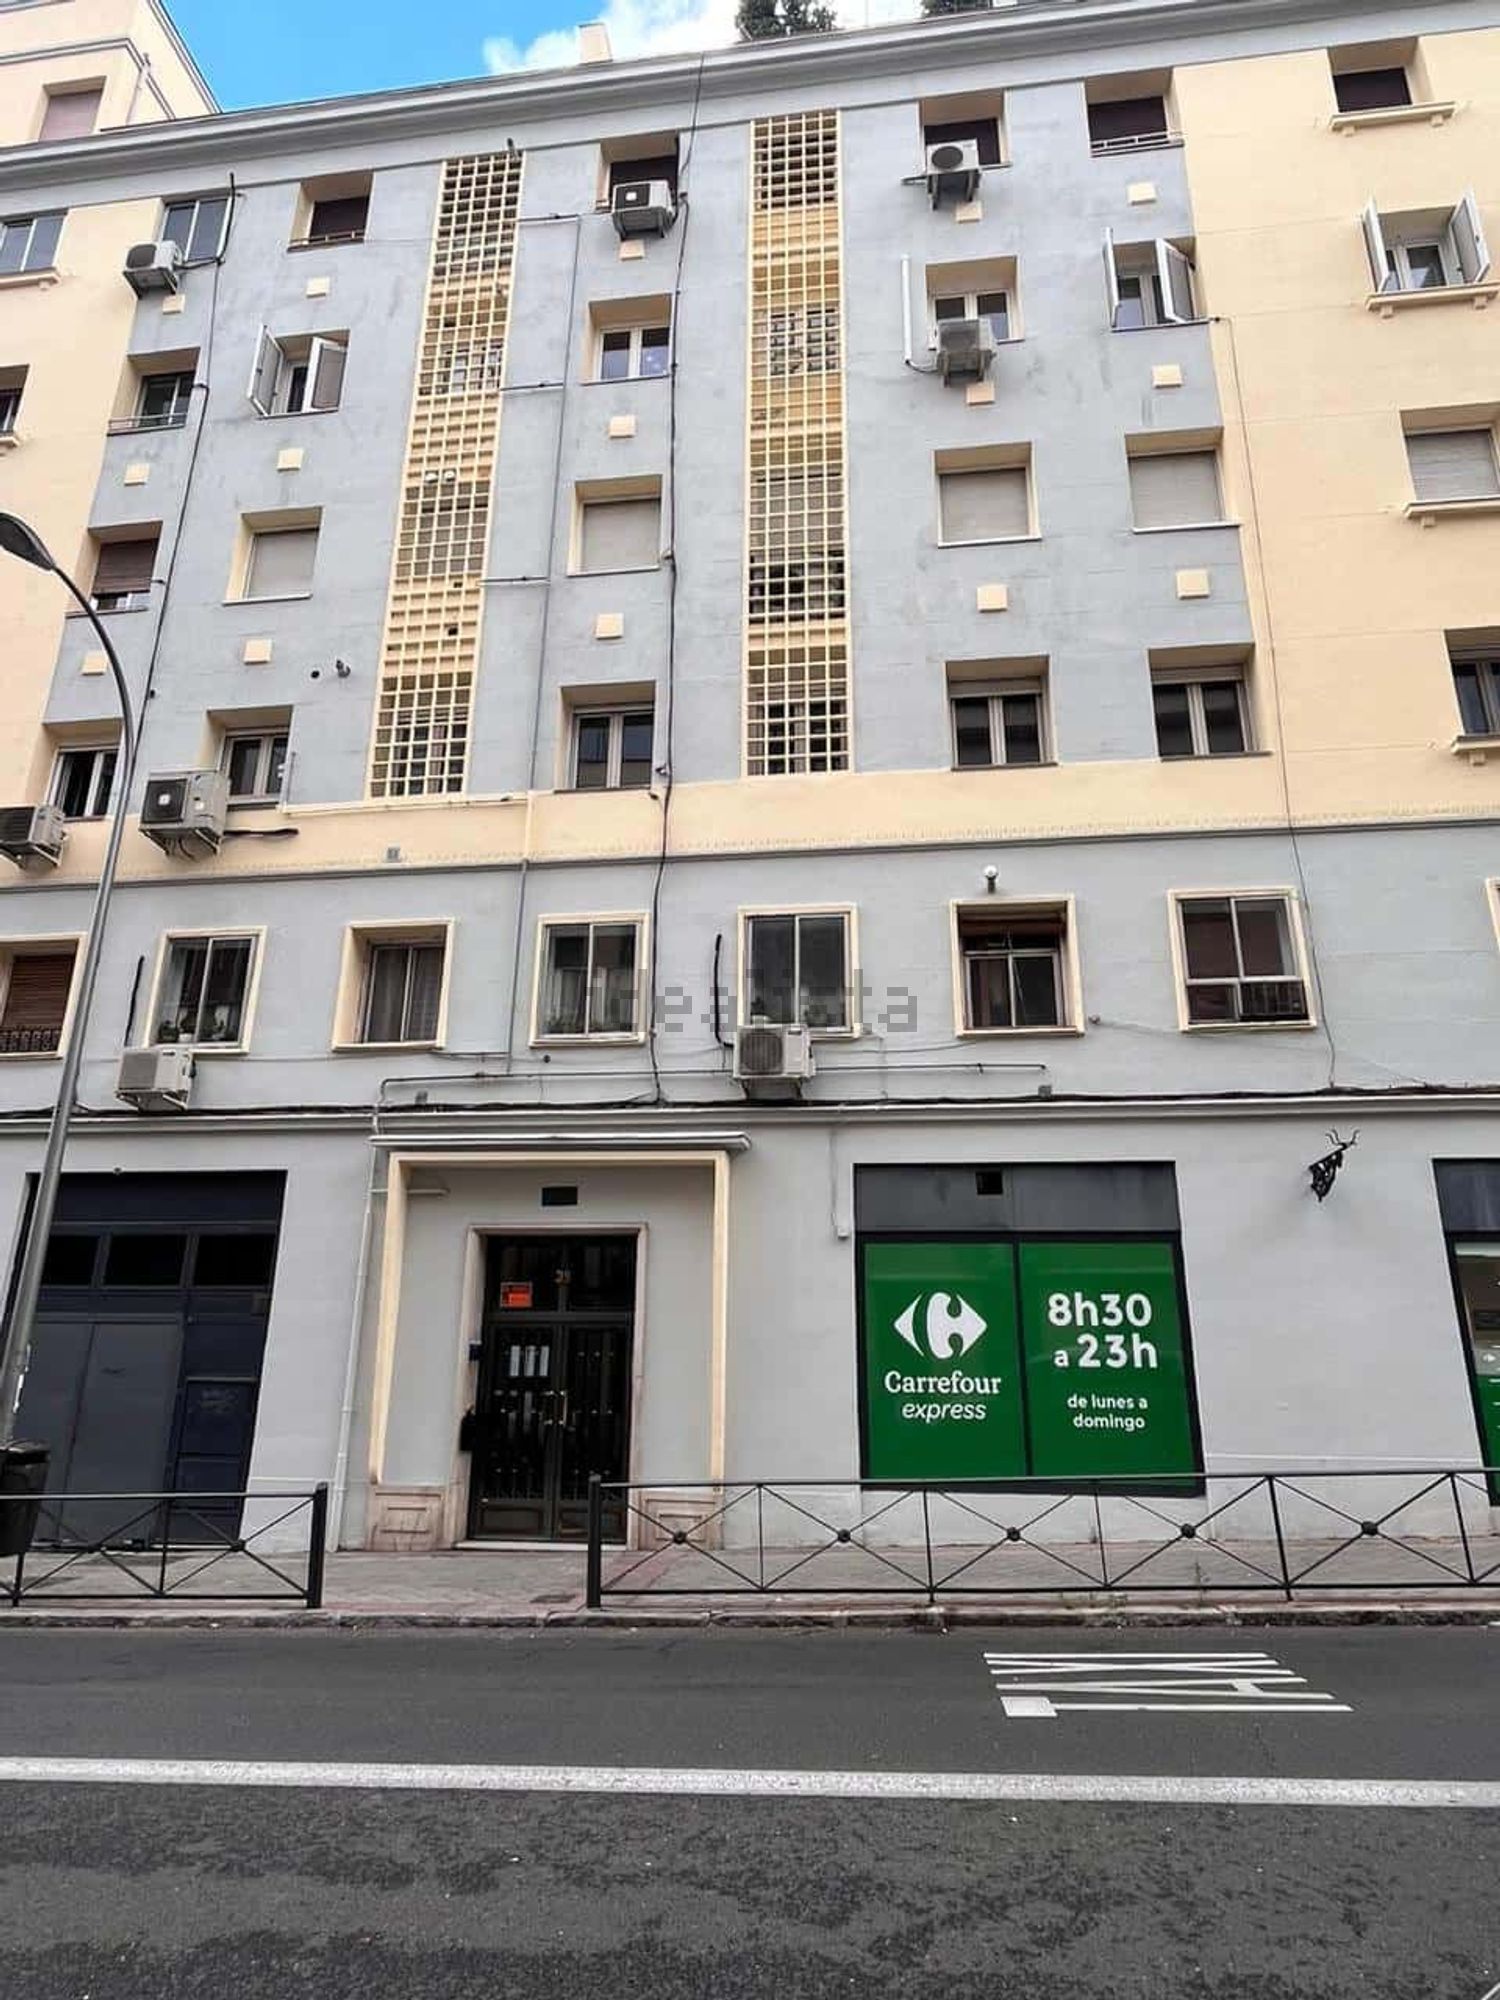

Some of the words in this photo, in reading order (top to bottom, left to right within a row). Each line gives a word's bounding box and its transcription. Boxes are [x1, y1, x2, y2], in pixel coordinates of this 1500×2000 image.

[1048, 1292, 1152, 1326] 8h30
[1053, 1349, 1069, 1367] a
[1077, 1333, 1157, 1368] 23h
[884, 1370, 1001, 1394] Carrefour
[1067, 1394, 1088, 1408] de
[1092, 1394, 1134, 1408] lunes
[1138, 1398, 1148, 1408] a
[902, 1403, 987, 1423] express
[1073, 1413, 1145, 1432] domingo
